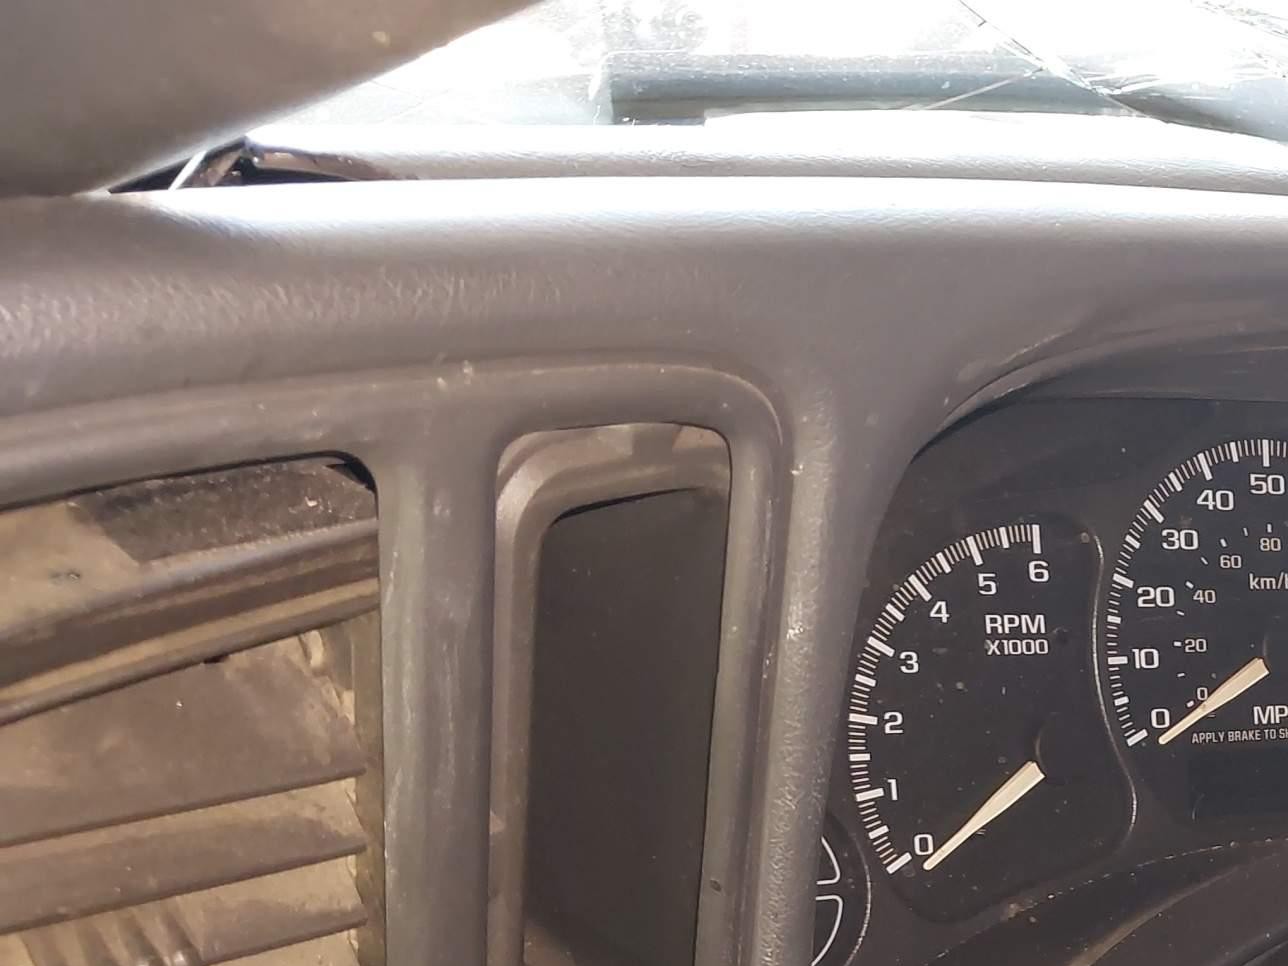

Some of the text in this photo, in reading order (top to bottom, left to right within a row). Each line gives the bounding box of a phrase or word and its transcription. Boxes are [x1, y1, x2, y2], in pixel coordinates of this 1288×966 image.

[1250, 474, 1285, 494] 50
[1197, 490, 1234, 510] 40
[1161, 530, 1198, 550] 30
[1260, 538, 1281, 551] 80
[1030, 561, 1049, 582] 6
[1220, 556, 1241, 569] 60
[978, 573, 997, 596] 5
[1137, 587, 1174, 607] 20
[1193, 590, 1216, 603] 40
[930, 601, 949, 623] 4
[986, 614, 1046, 635] RPM
[987, 639, 1048, 655] X1000
[1185, 639, 1207, 652] 20
[900, 652, 919, 673] 3
[1132, 648, 1159, 669] 10
[1197, 688, 1208, 700] 0
[884, 712, 904, 734] 2
[1151, 709, 1170, 728] 0
[1192, 732, 1225, 744] APPLY
[1228, 729, 1261, 741] BRAKE
[1263, 729, 1276, 740] TO
[887, 779, 898, 800] 1
[915, 834, 933, 856] 0
